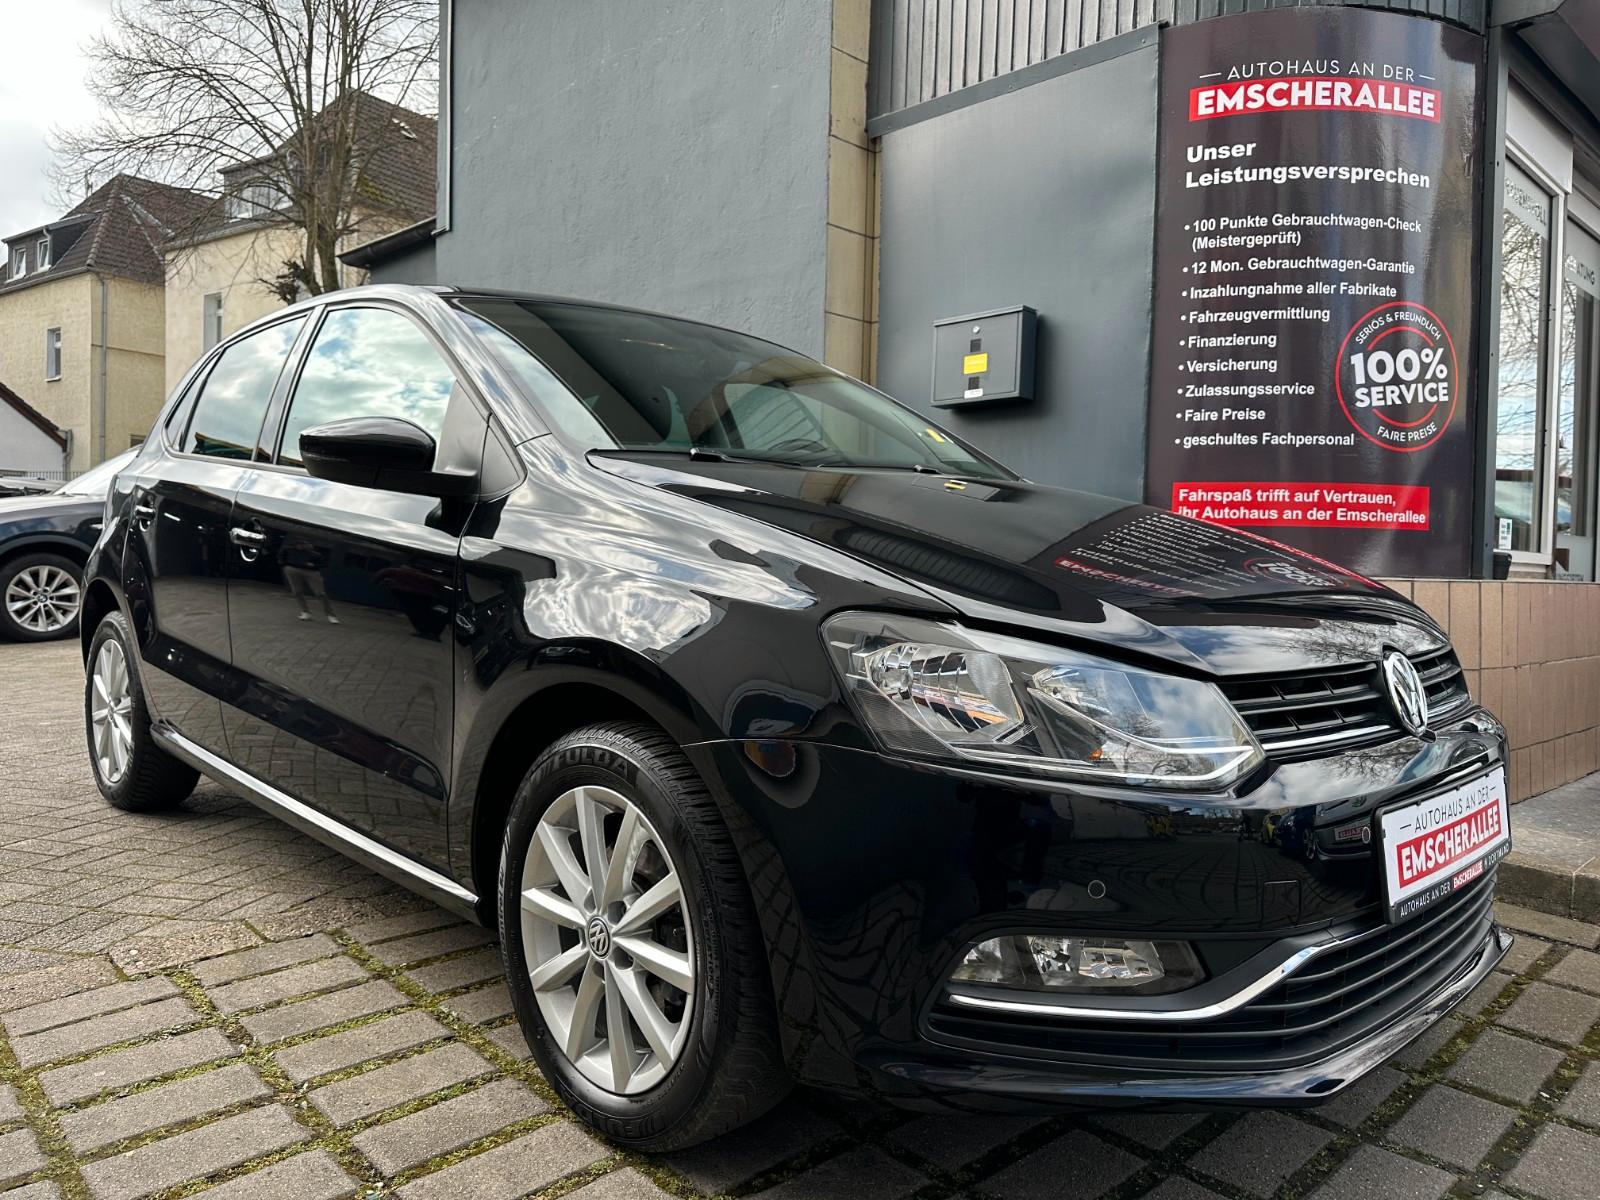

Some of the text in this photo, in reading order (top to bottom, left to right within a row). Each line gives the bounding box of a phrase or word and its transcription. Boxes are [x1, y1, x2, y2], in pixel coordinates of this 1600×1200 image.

[1227, 59, 1415, 82] AUTOHAUS AN DER
[1197, 80, 1435, 118] EMSCHERALLEE
[1186, 142, 1256, 163] Unser
[1186, 165, 1430, 188] Leistungsversprechen
[1193, 213, 1421, 234] 100 Punkte Gebrauchtwagen-Check
[1192, 231, 1301, 252] (Meistergeprüft)
[1191, 256, 1415, 275] 12 Mon. Gebrauchtwagen-Garantie
[1190, 282, 1397, 300] Inzahlungnahme aller Fabrikate
[1189, 307, 1331, 324] Fahrzeugvermittlung
[1355, 311, 1442, 345] SERIÖS & FREUNDLICH
[1188, 333, 1277, 349] Finanzierung
[1186, 358, 1278, 374] Versicherung
[1350, 347, 1448, 385] 100%
[1185, 383, 1315, 399] Zulassungsservice
[1354, 382, 1449, 408] SERVICE
[1184, 408, 1266, 422] Faire Preise
[1183, 432, 1355, 449] geschultes Fachpersonal
[1377, 421, 1437, 442] FAIRE PREISE
[1178, 488, 1397, 506] Fahrspaß trifft auf Vertrauen,
[1202, 506, 1278, 520] Autohaus
[1282, 509, 1303, 520] an
[1306, 508, 1332, 521] der
[1336, 508, 1426, 524] Emscherallee
[1415, 785, 1489, 833] AUTOHAUS AN DER
[1401, 804, 1499, 881] EMSCHERALLEE
[1400, 893, 1430, 918] AUTOHAUS
[1431, 887, 1440, 900] AN
[1440, 881, 1451, 896] DER
